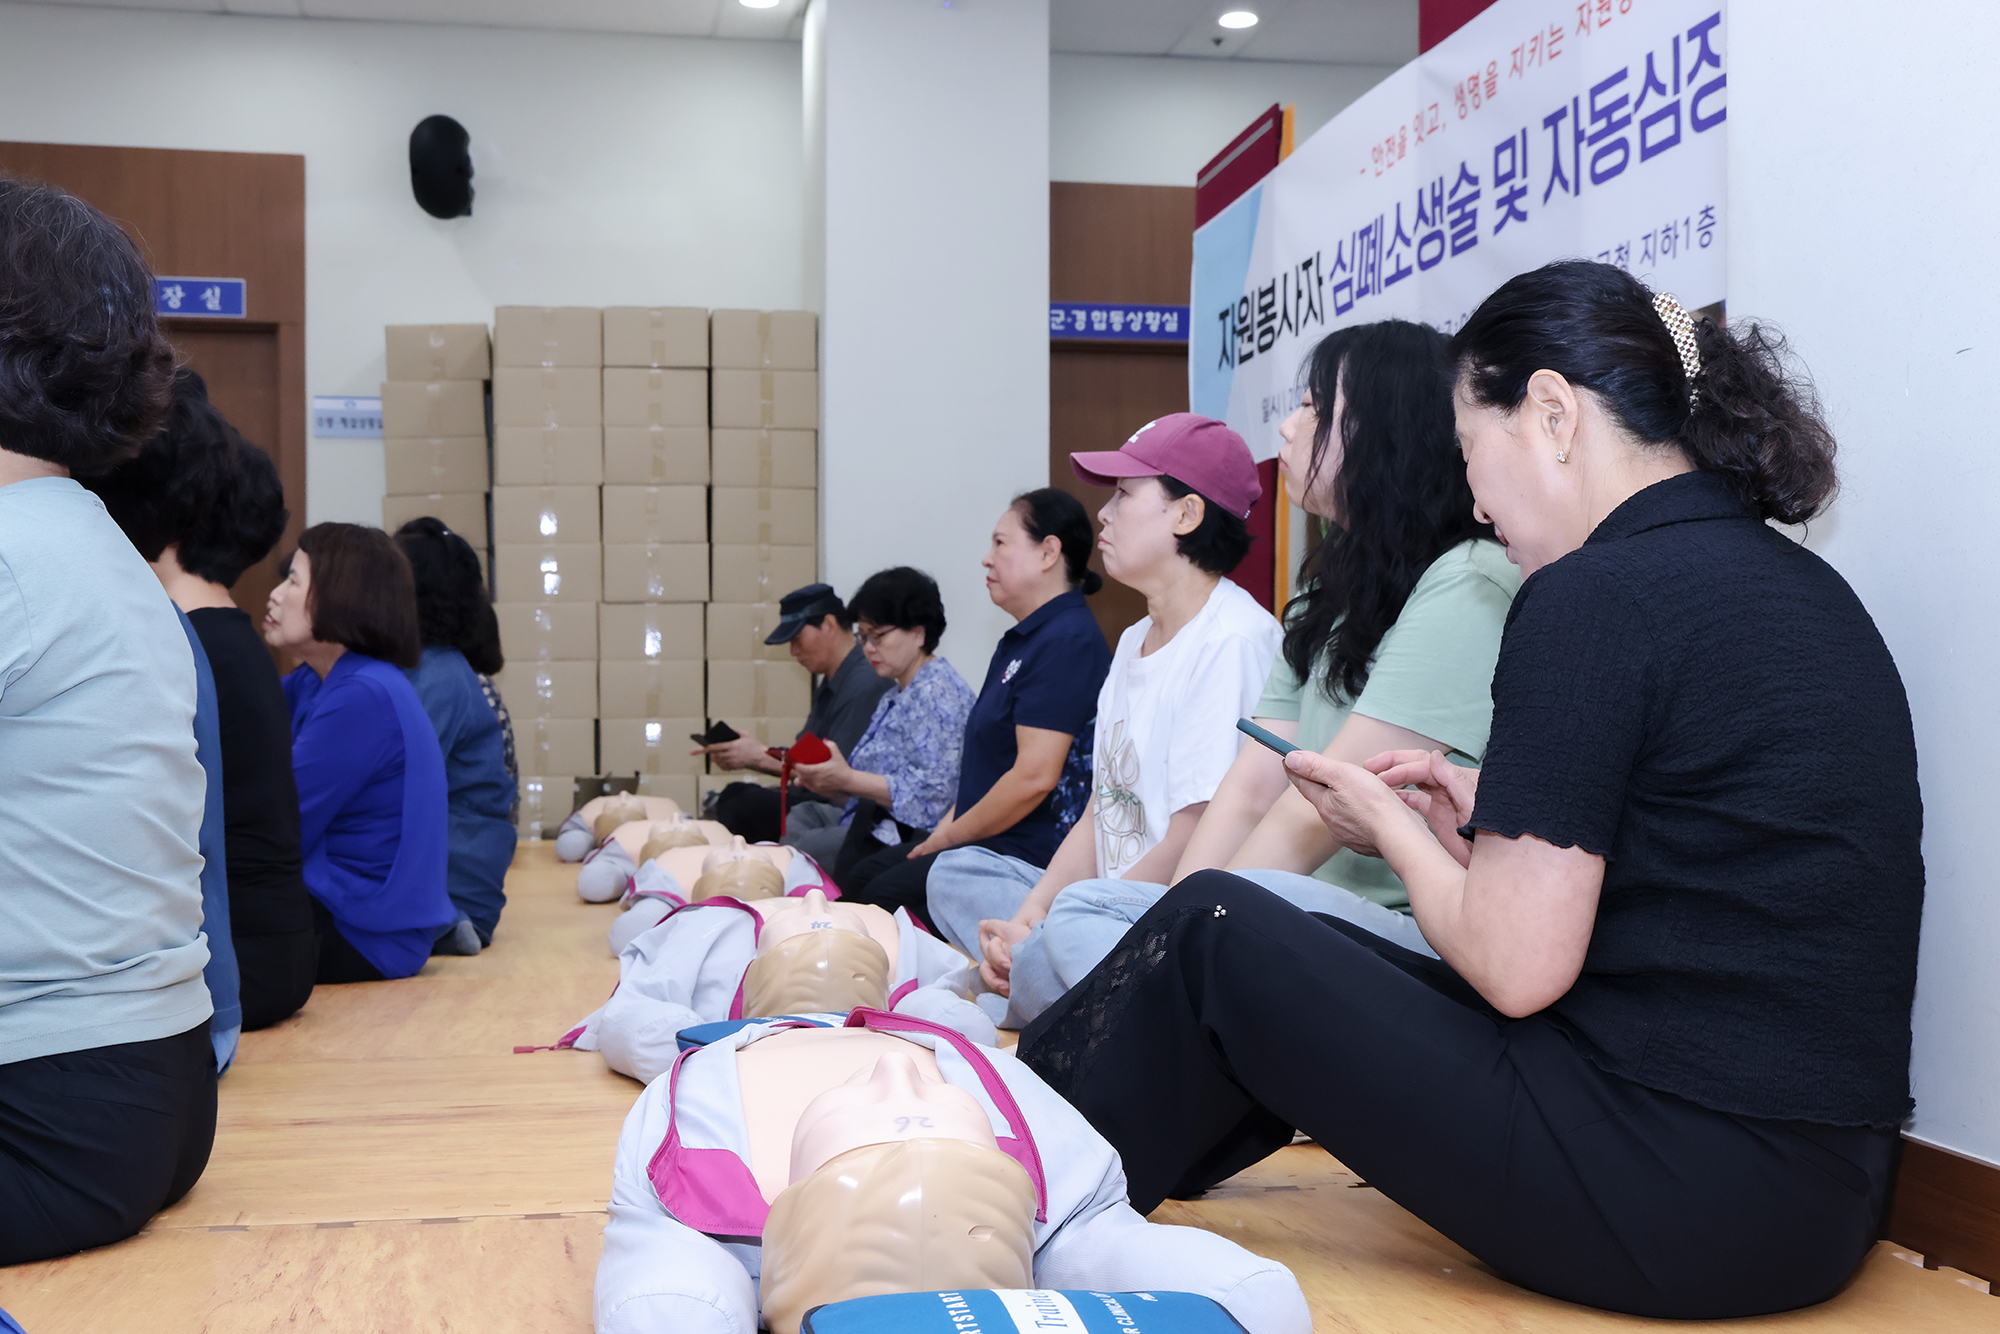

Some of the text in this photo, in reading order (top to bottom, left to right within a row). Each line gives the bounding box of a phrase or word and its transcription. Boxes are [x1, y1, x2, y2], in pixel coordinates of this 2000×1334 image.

[1371, 125, 1407, 178] 안전을
[1454, 60, 1499, 120] 생명을
[1508, 23, 1565, 80] 지키는
[1218, 250, 1324, 372] 자원봉사자
[1329, 160, 1481, 317] 심폐소생술
[1493, 126, 1528, 236] 및
[893, 1116, 935, 1133] 26
